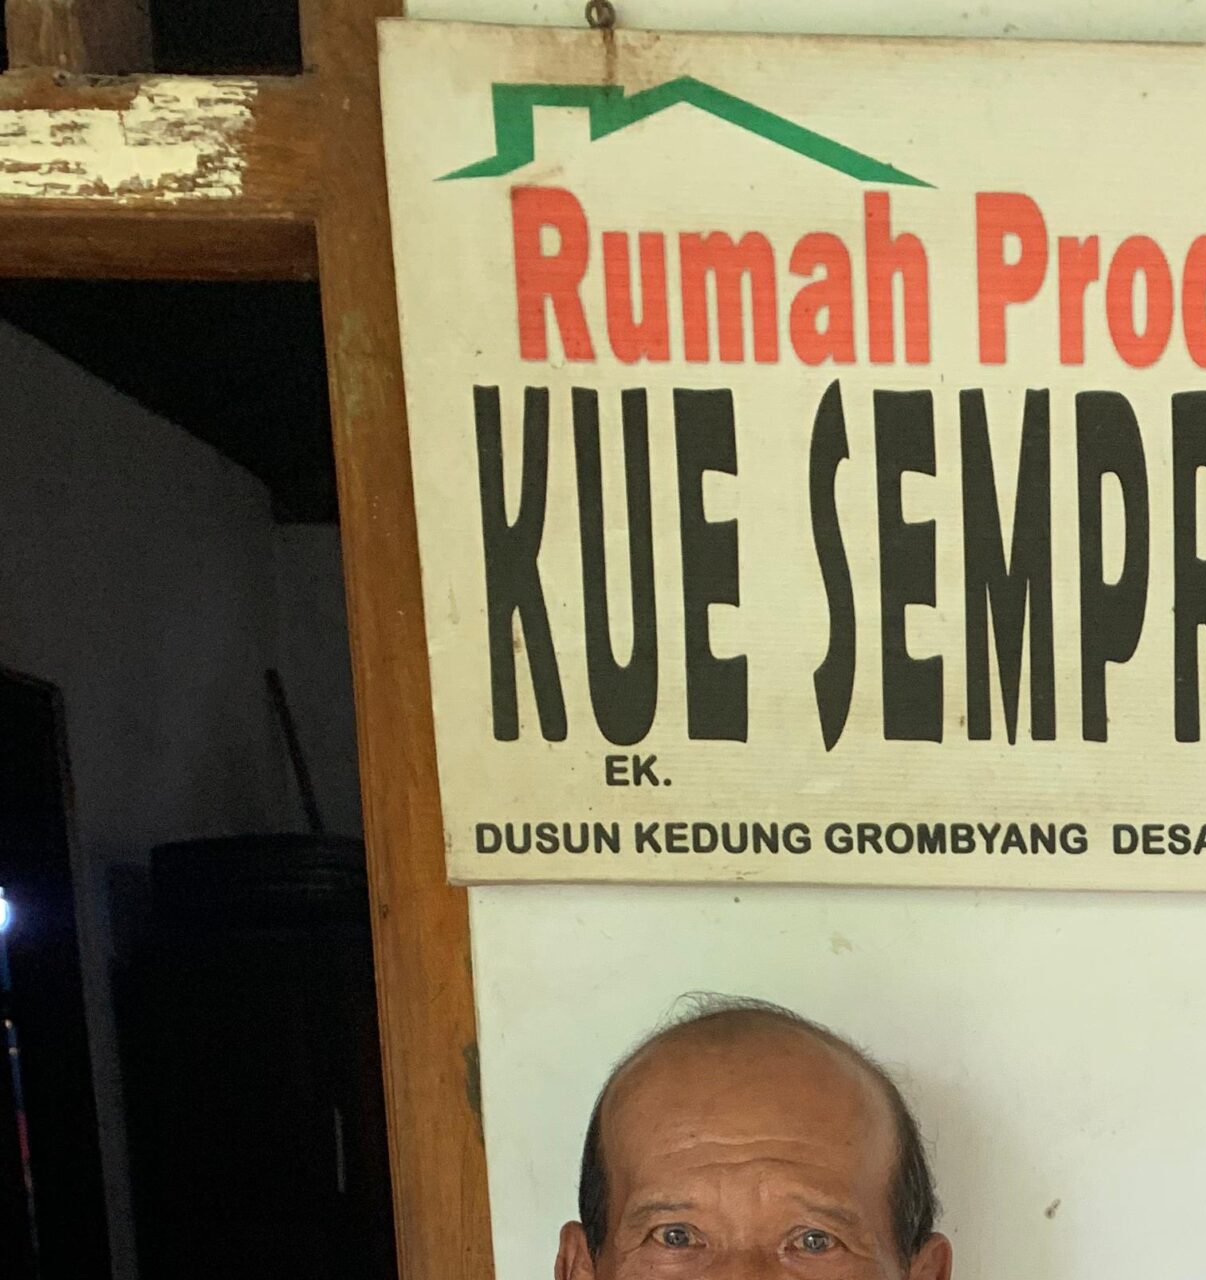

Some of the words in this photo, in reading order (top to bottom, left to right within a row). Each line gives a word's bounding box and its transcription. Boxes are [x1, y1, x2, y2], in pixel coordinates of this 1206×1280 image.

[510, 185, 932, 367] Rumah
[473, 384, 750, 748] KUE
[605, 754, 672, 787] EK.
[475, 822, 621, 854] DUSUN
[634, 822, 812, 854] KEDUNG
[824, 822, 1088, 855] GROMBYANG
